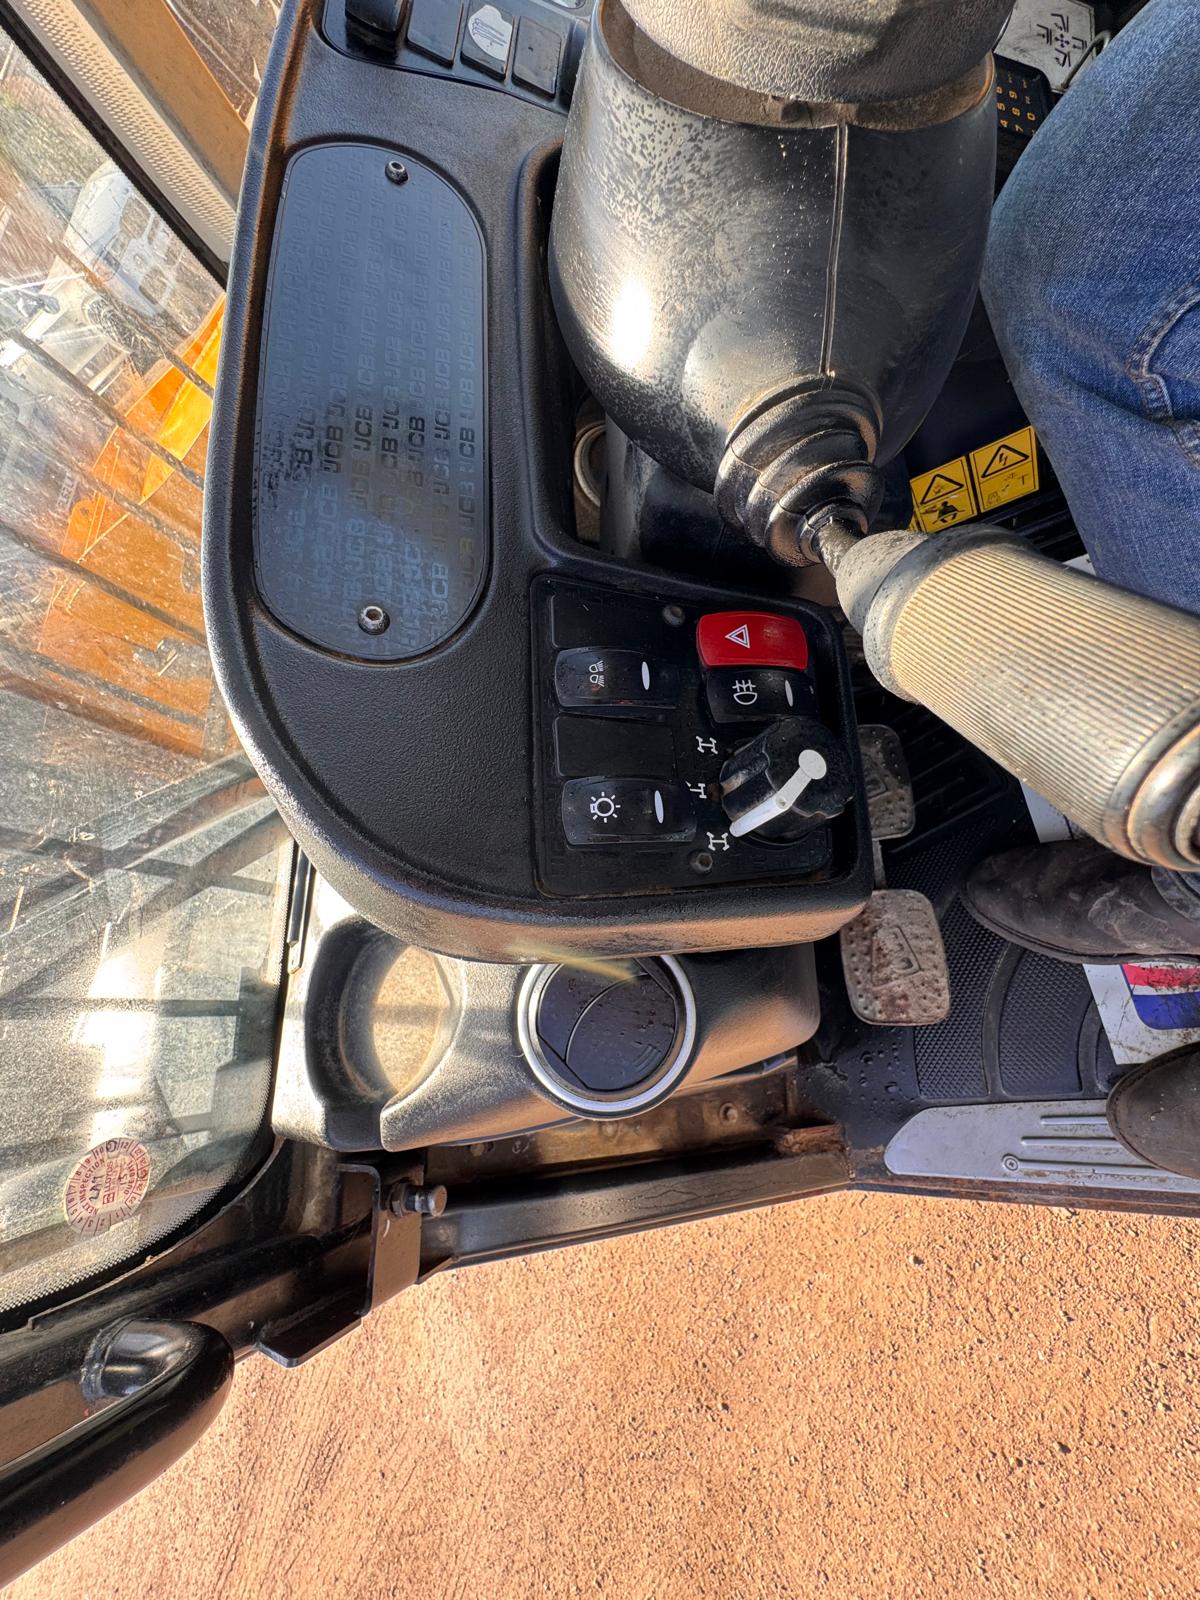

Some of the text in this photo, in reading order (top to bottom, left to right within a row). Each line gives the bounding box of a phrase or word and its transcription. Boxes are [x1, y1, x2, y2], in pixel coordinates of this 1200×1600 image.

[435, 348, 451, 390] JCB
[382, 385, 400, 430] JCB
[434, 397, 452, 440] JCB
[459, 378, 475, 420] JCB
[324, 425, 344, 473] JCB
[354, 405, 373, 451] JCB
[408, 416, 426, 462] JCB
[459, 427, 475, 471] JCB
[319, 483, 339, 536] JCB
[459, 481, 475, 531] JCB
[432, 563, 449, 617] JCB
[79, 1157, 106, 1203] INSPECTION
[104, 1160, 114, 1193] LLOYDS
